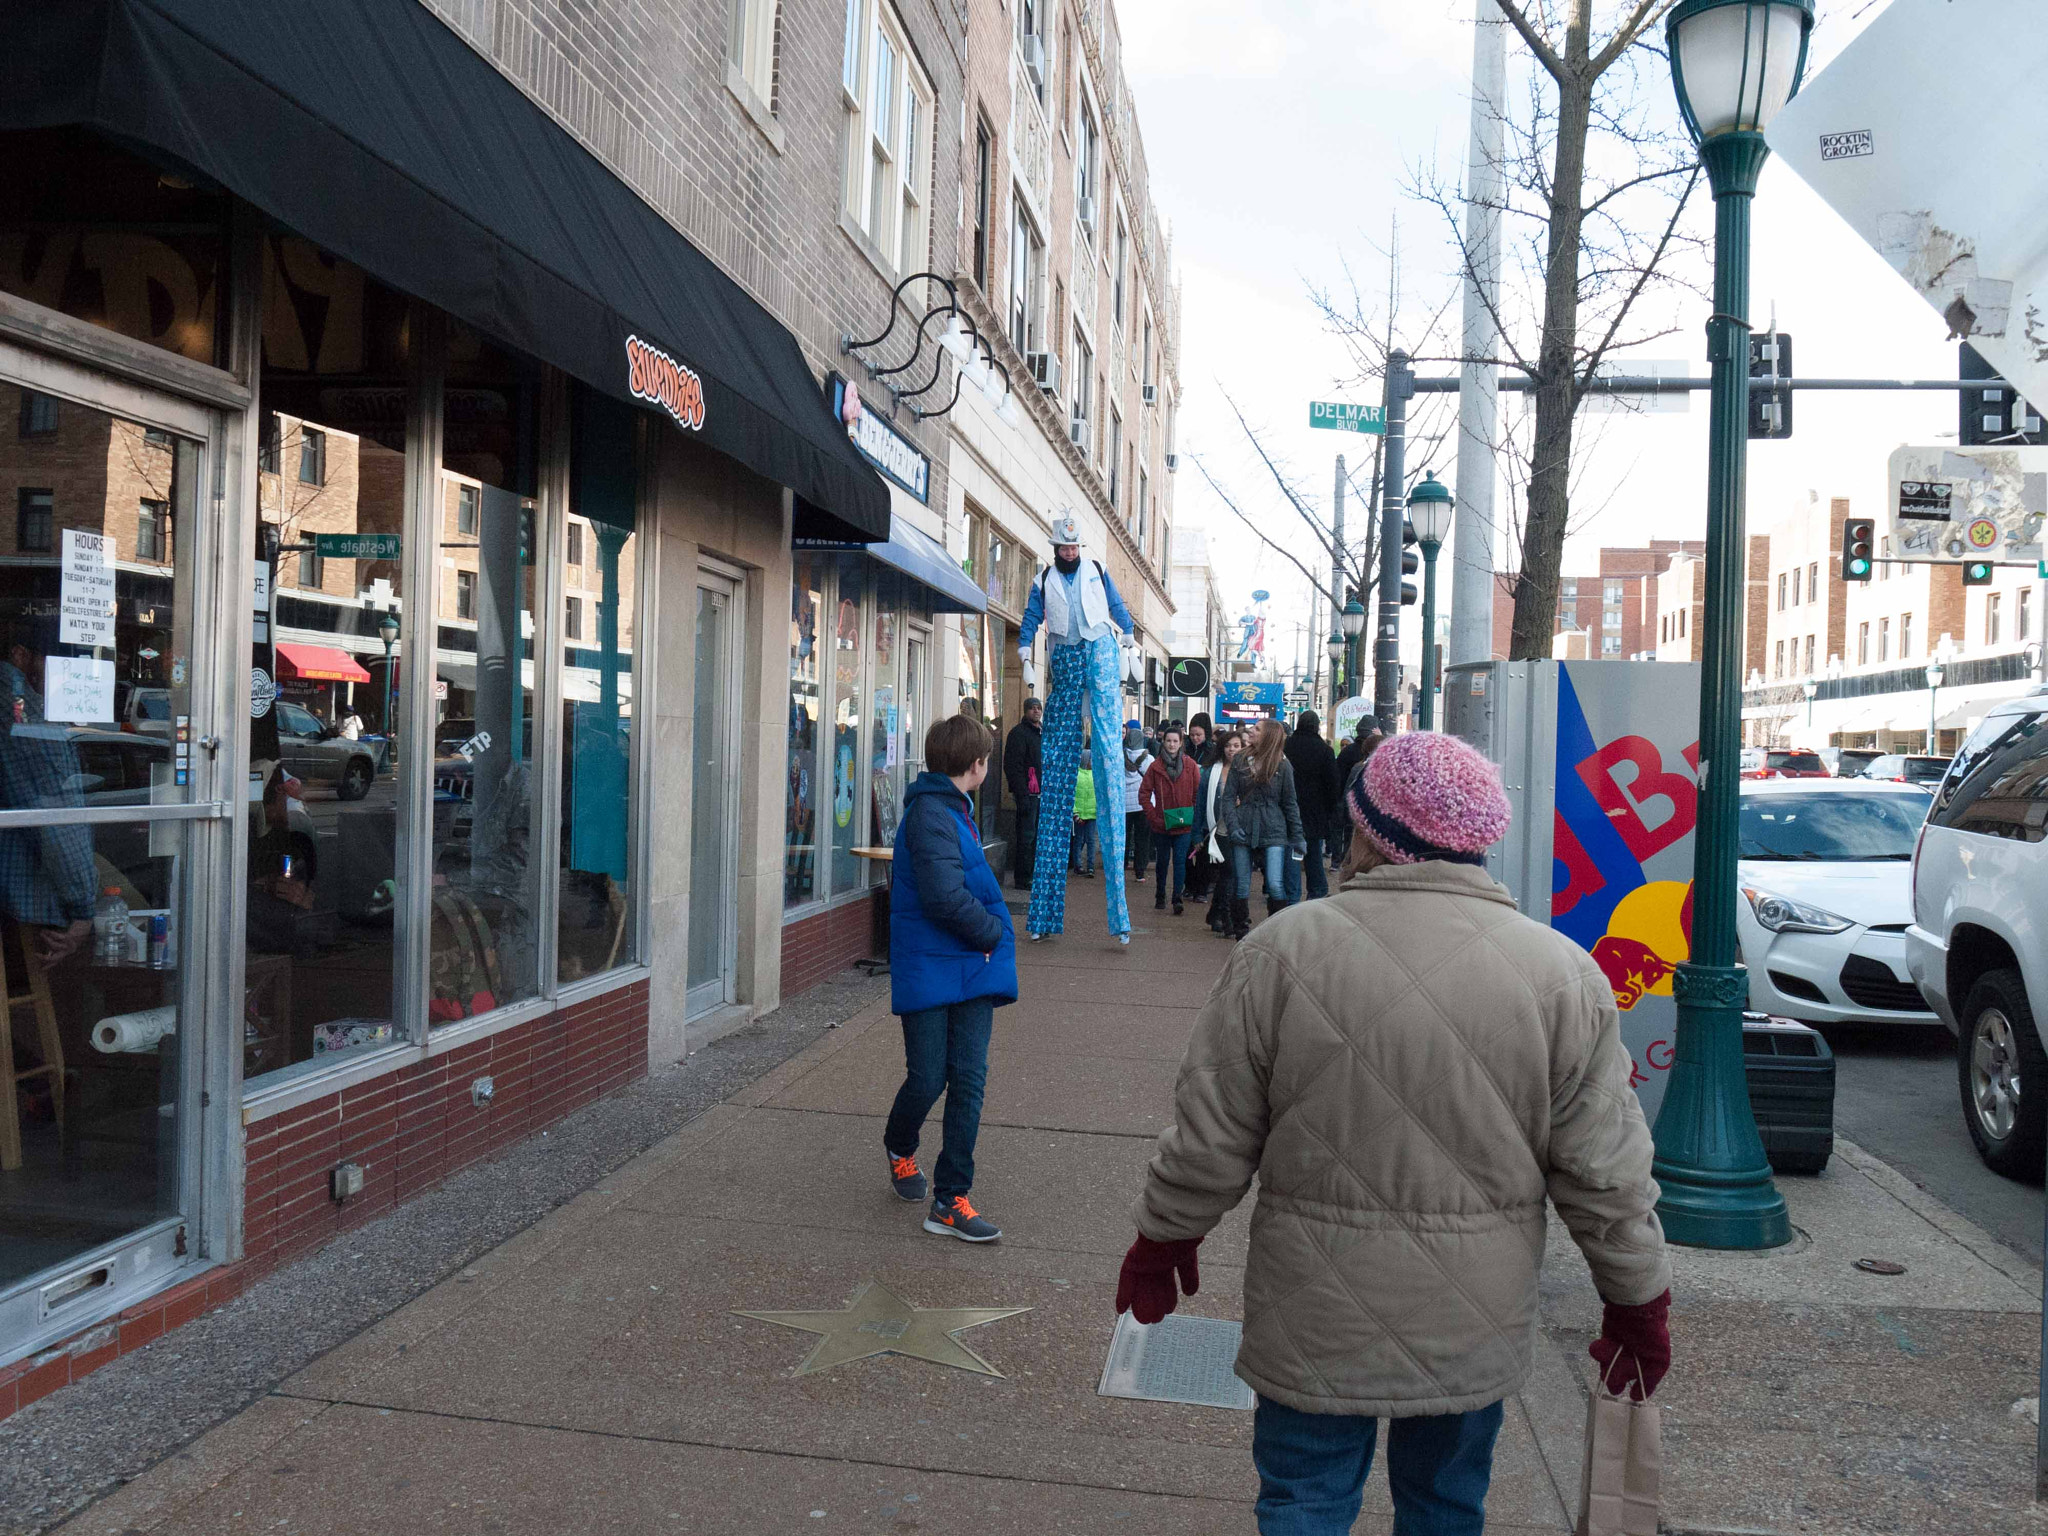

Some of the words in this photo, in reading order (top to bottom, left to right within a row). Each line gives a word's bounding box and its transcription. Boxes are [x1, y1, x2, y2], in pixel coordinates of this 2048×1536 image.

[1823, 133, 1870, 147] ROCKTIN
[1824, 145, 1861, 158] GROVE
[1315, 403, 1380, 422] DELMAR
[1337, 420, 1358, 431] BLVD
[75, 534, 104, 552] HOURS
[74, 552, 93, 562] SUNDAY
[74, 563, 93, 572] MONDAY
[67, 595, 85, 605] ALWAYS
[88, 598, 101, 606] OPEN
[69, 619, 88, 629] WATCH
[91, 621, 105, 631] YOUR
[81, 633, 96, 643] STEP
[459, 731, 492, 763] FTP
